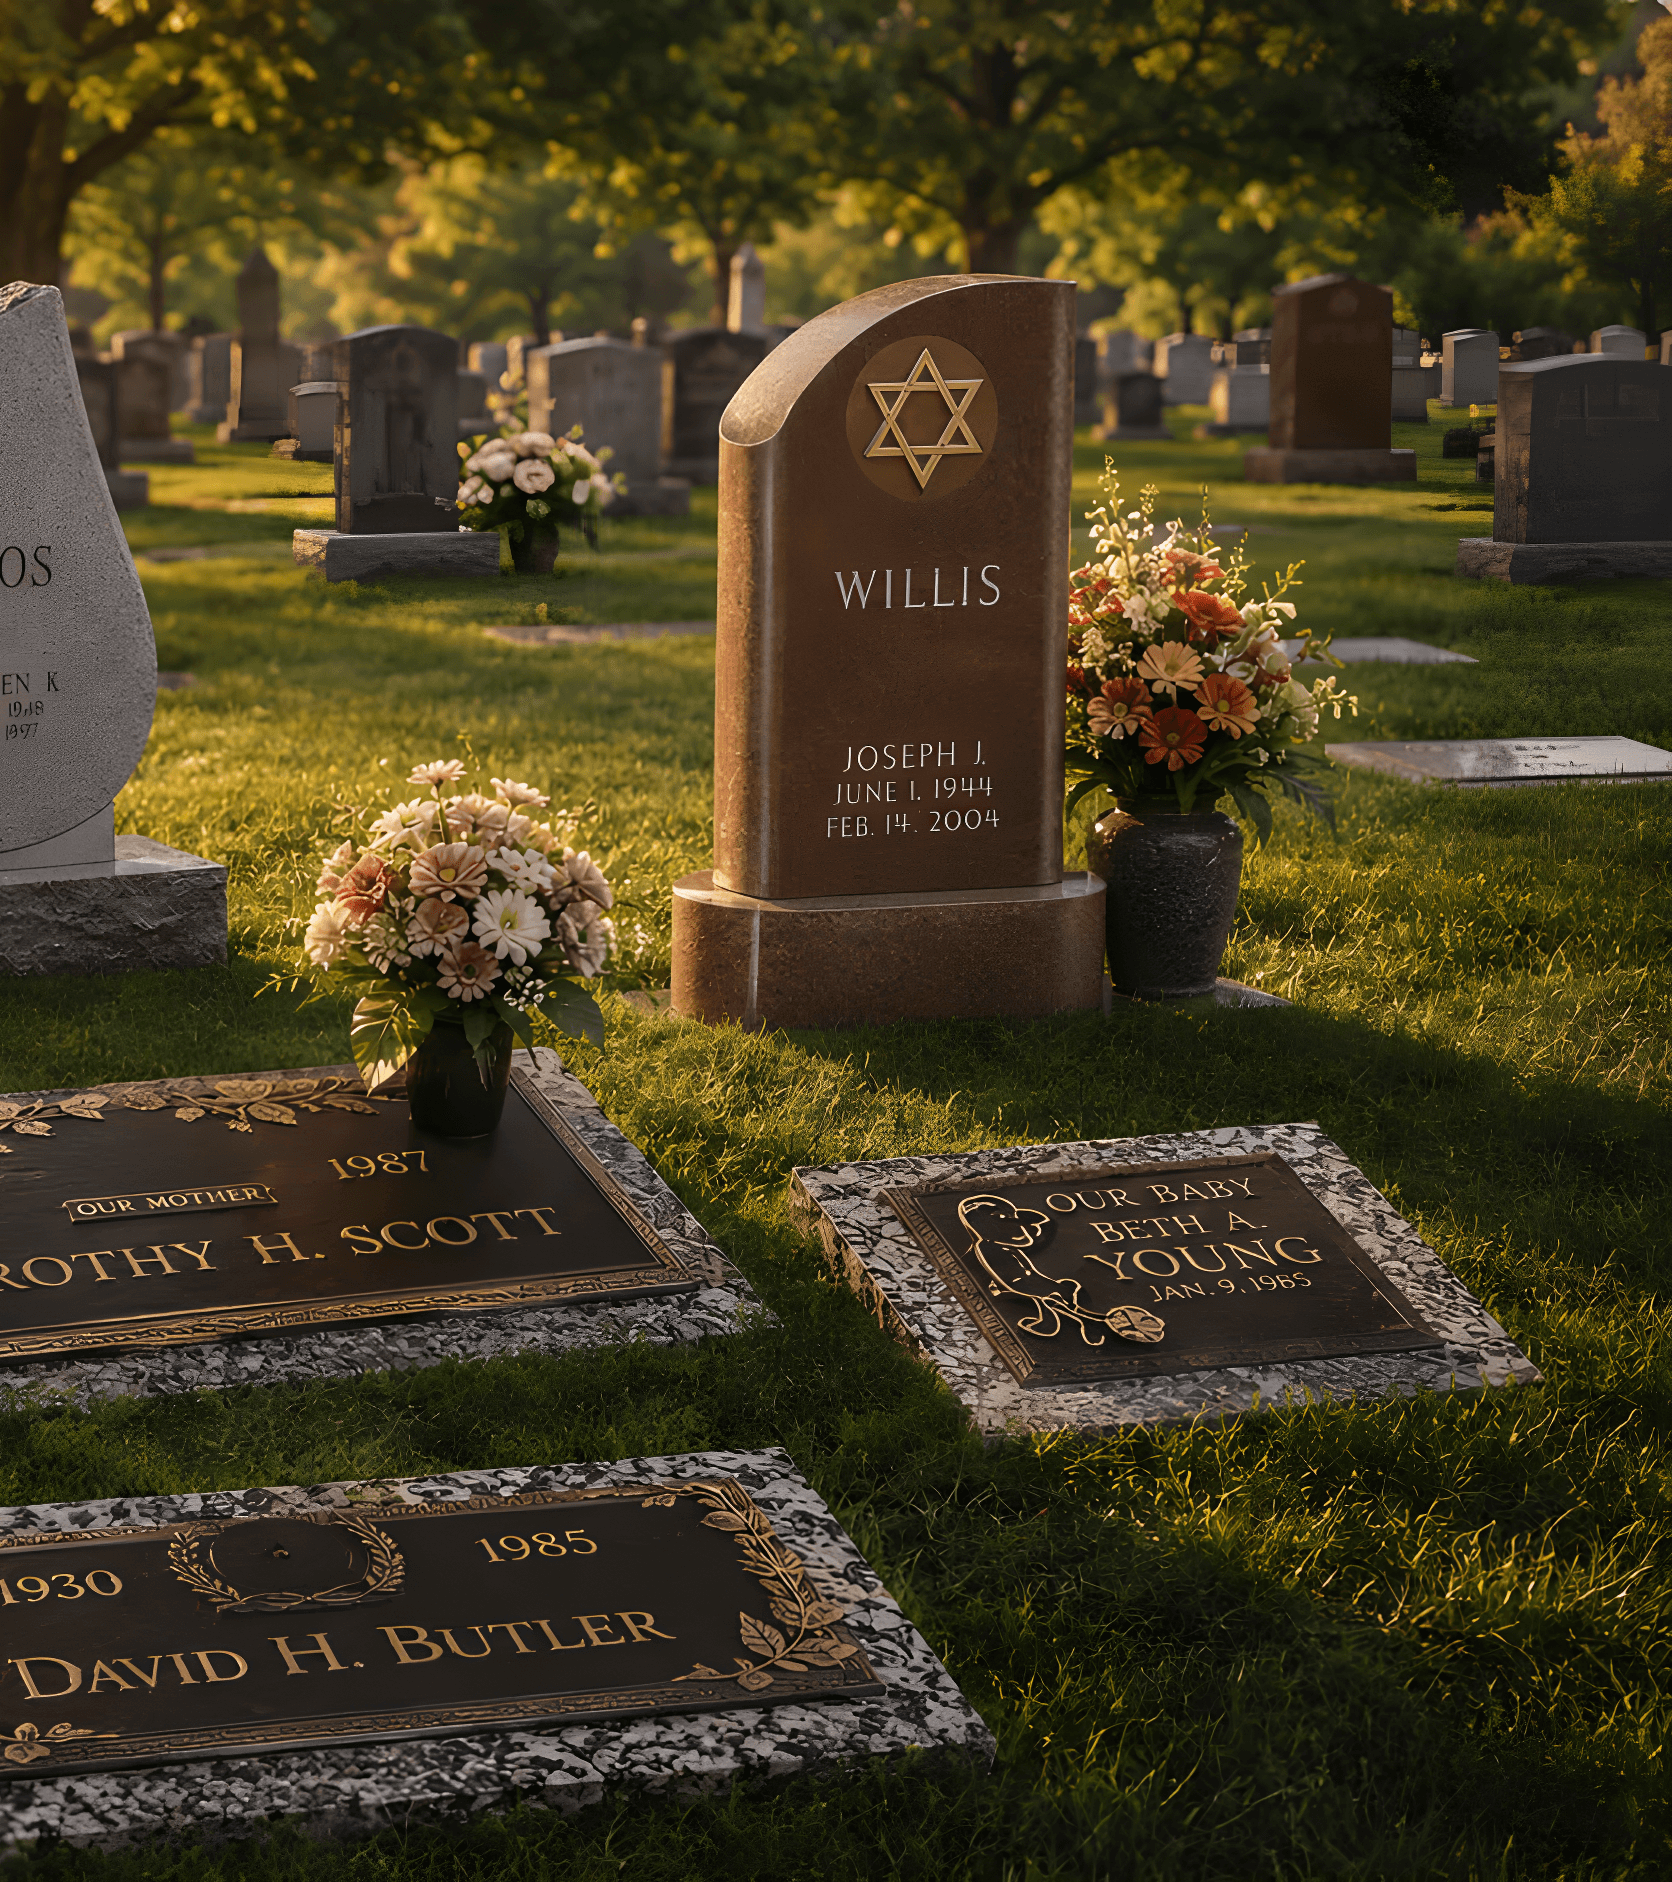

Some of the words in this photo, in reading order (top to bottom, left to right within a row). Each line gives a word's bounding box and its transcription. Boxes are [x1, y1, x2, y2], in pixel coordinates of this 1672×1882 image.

[834, 564, 1001, 609] WILLIS
[842, 741, 955, 773] JOSEPH
[973, 740, 986, 765] J.
[832, 780, 898, 806] JUNE
[935, 776, 993, 799] 1944
[827, 815, 874, 838] FEB.
[929, 808, 1000, 832] 2004
[328, 1149, 430, 1181] 1987
[76, 1199, 137, 1216] OUR
[1045, 1188, 1141, 1213] OUR
[1146, 1177, 1256, 1204] BABY
[251, 1231, 326, 1266] H.
[339, 1206, 564, 1257] SCOTT
[1088, 1214, 1212, 1244] BETH
[1226, 1210, 1268, 1232] A.
[1083, 1236, 1324, 1281] YOUNG
[1149, 1282, 1216, 1303] JAN.
[1247, 1271, 1312, 1292] 1965
[474, 1529, 599, 1564] 1985
[8, 1649, 250, 1700] DAVID
[267, 1632, 366, 1676] H.
[376, 1610, 677, 1666] BUTLER
